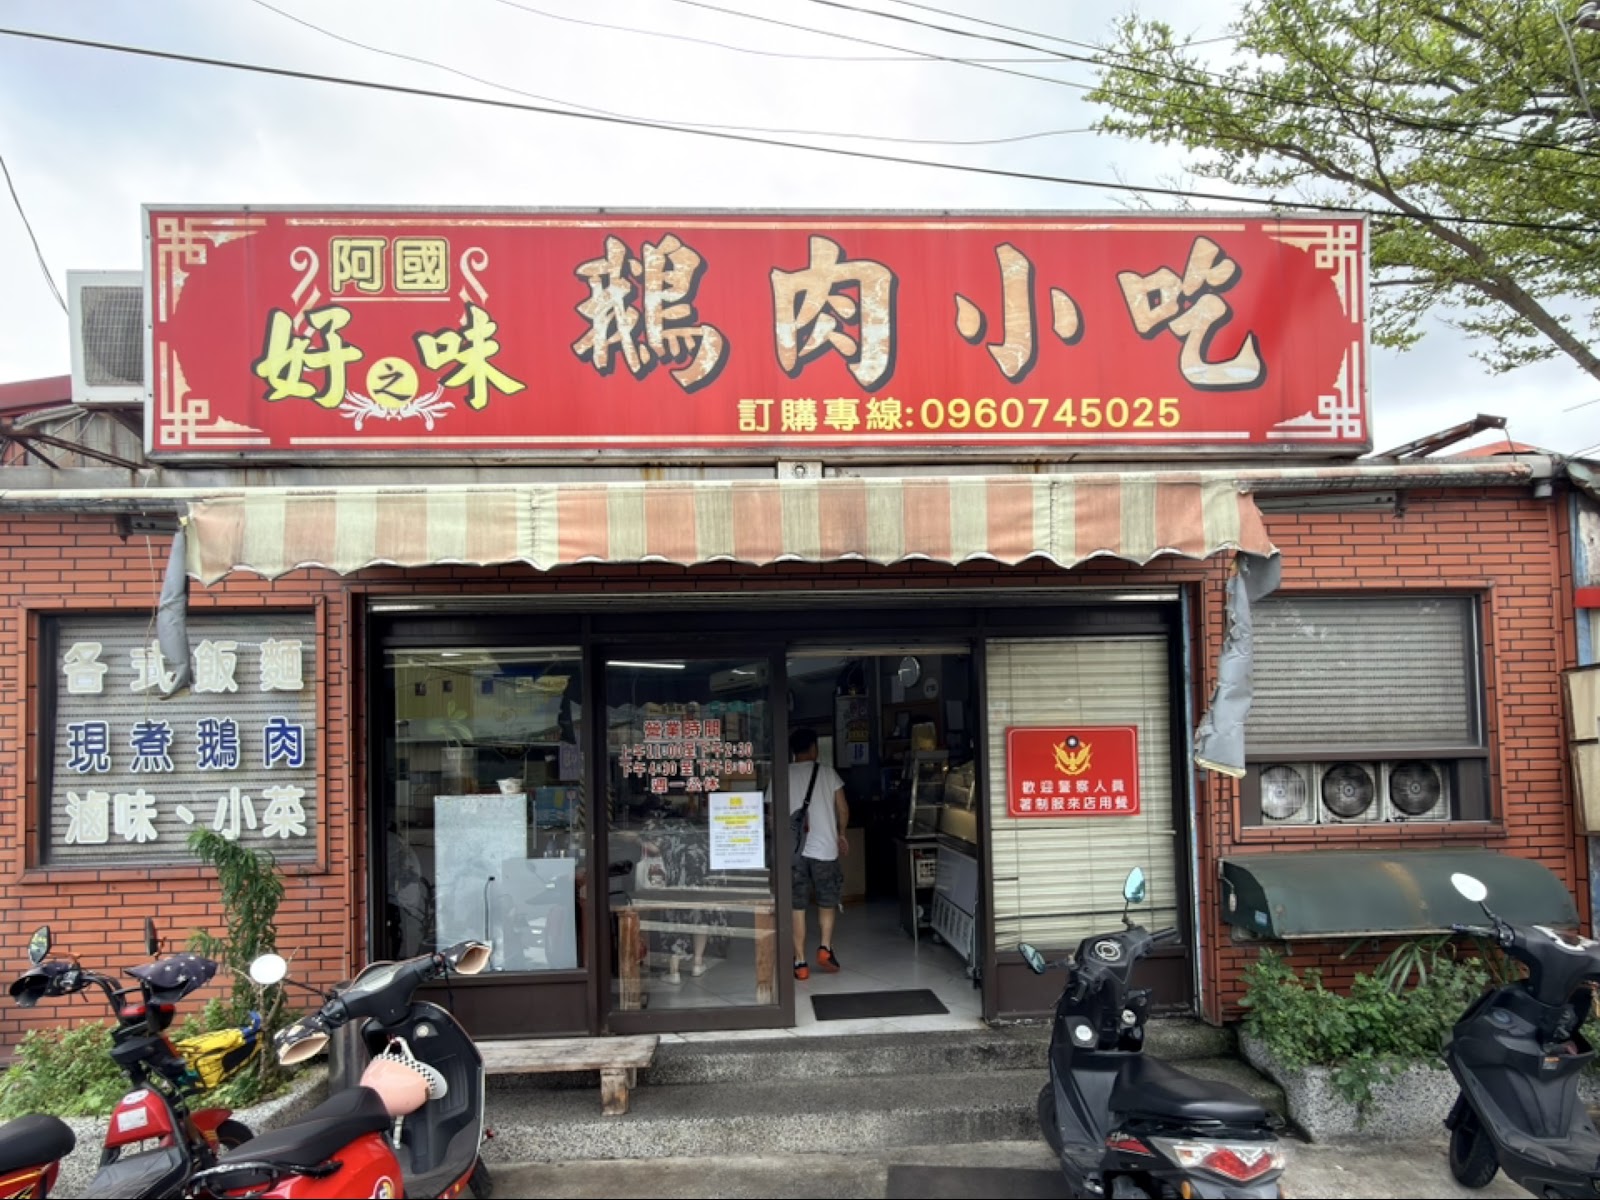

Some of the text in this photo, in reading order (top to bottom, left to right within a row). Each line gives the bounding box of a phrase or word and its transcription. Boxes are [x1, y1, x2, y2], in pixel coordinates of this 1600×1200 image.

[331, 236, 450, 293] 阿國
[571, 233, 1268, 393] 鵝肉小吃
[737, 396, 1182, 434] 訂購專線:0960745025
[66, 717, 306, 773] 現煮鵝肉
[644, 719, 721, 738] 營業時間
